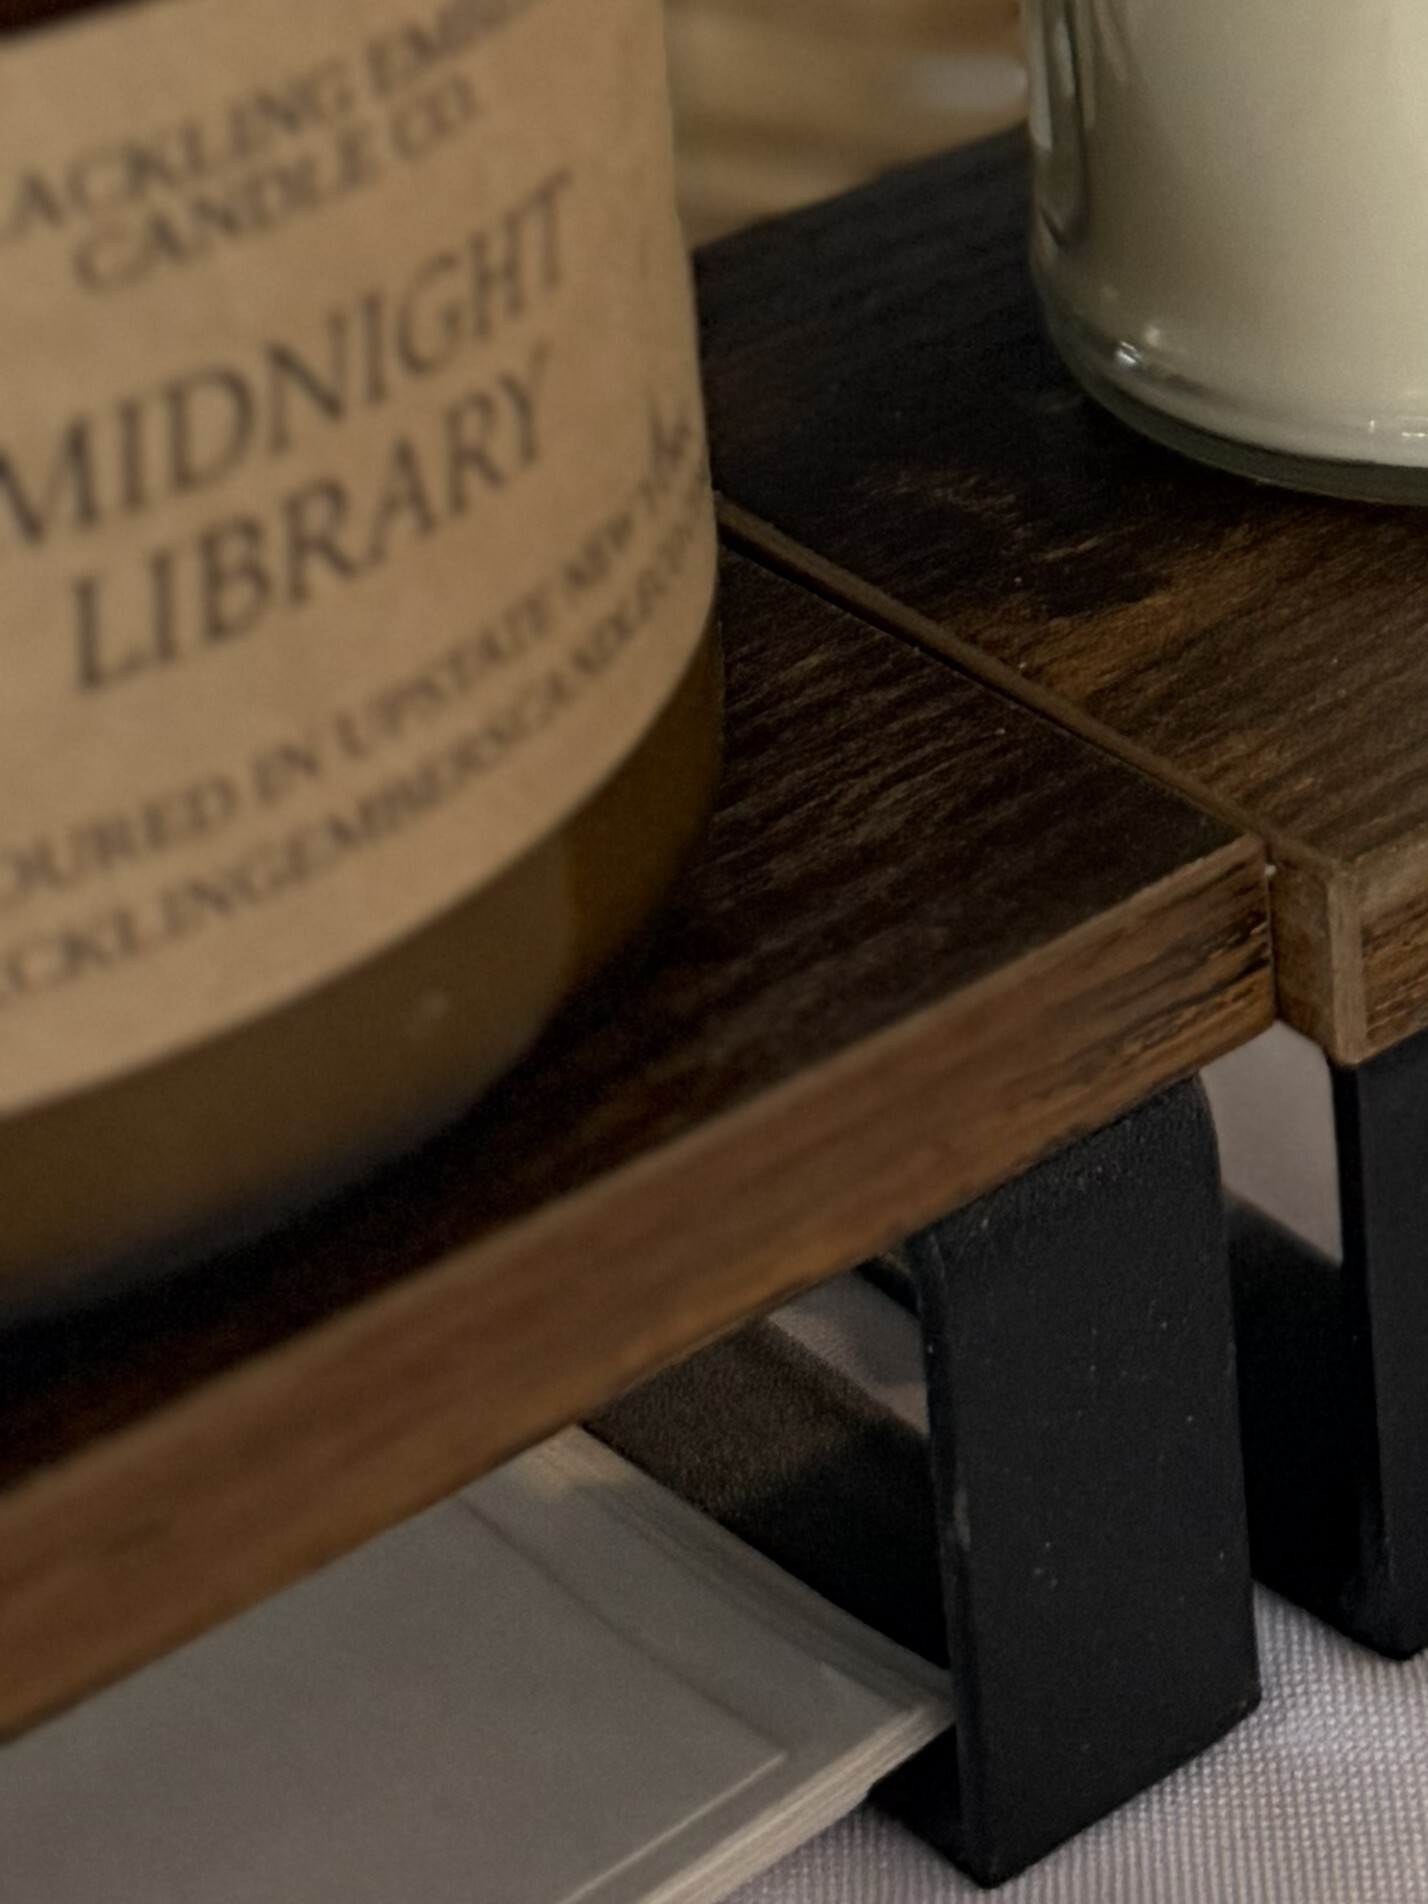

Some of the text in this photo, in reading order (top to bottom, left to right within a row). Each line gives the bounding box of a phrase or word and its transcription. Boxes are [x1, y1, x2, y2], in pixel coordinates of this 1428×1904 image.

[0, 162, 576, 548] MIDNIGHT
[70, 120, 376, 294] CANDLE
[72, 334, 552, 698] LIBRARY
